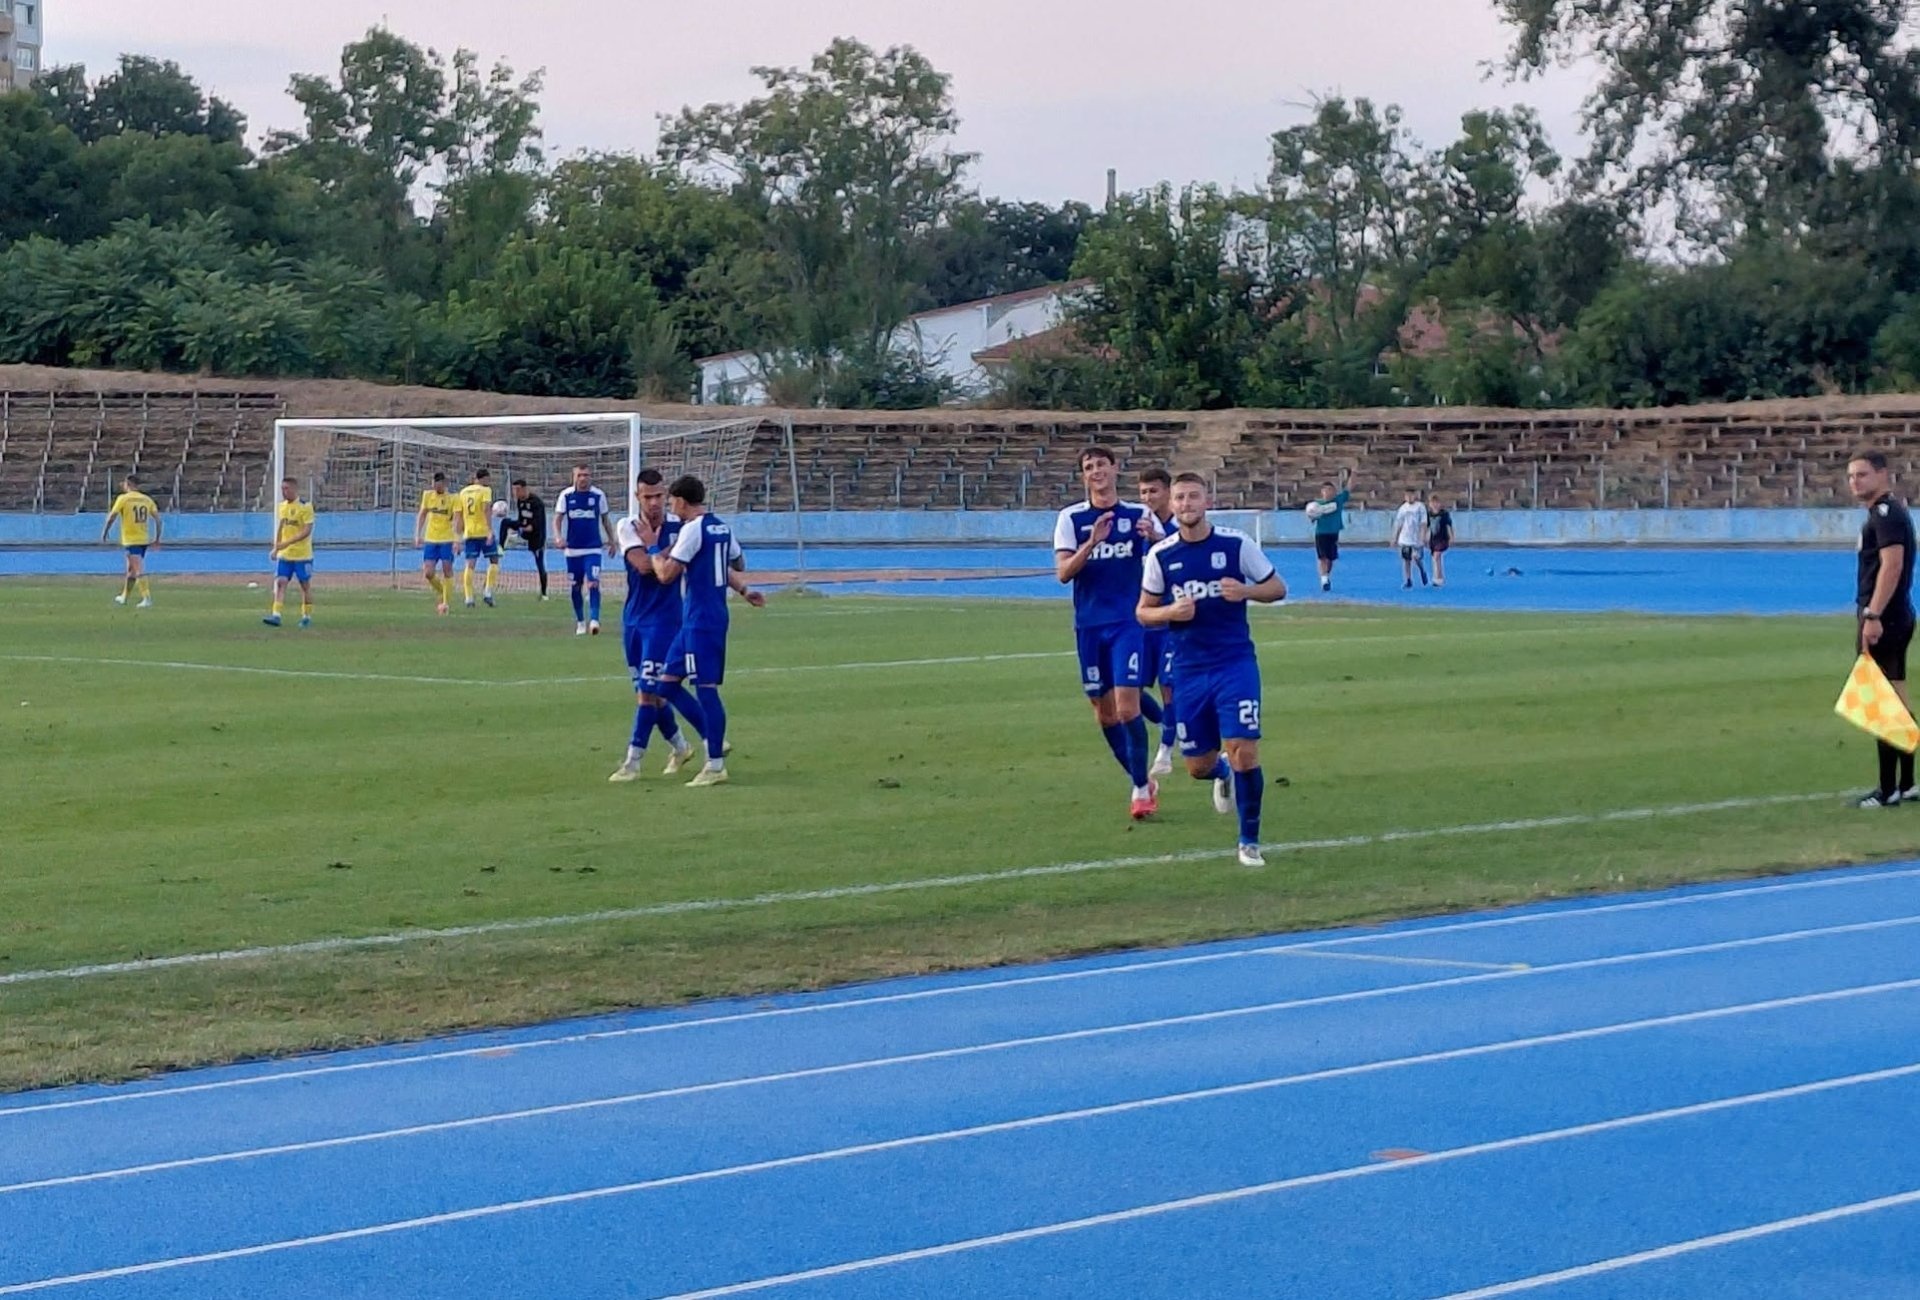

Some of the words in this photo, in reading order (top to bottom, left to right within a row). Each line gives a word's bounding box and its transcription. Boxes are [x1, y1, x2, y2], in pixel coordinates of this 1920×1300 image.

[467, 497, 475, 516] 2
[1088, 540, 1133, 560] fbet
[715, 541, 728, 587] 11
[1171, 580, 1222, 602] efbe
[1128, 652, 1139, 673] 4
